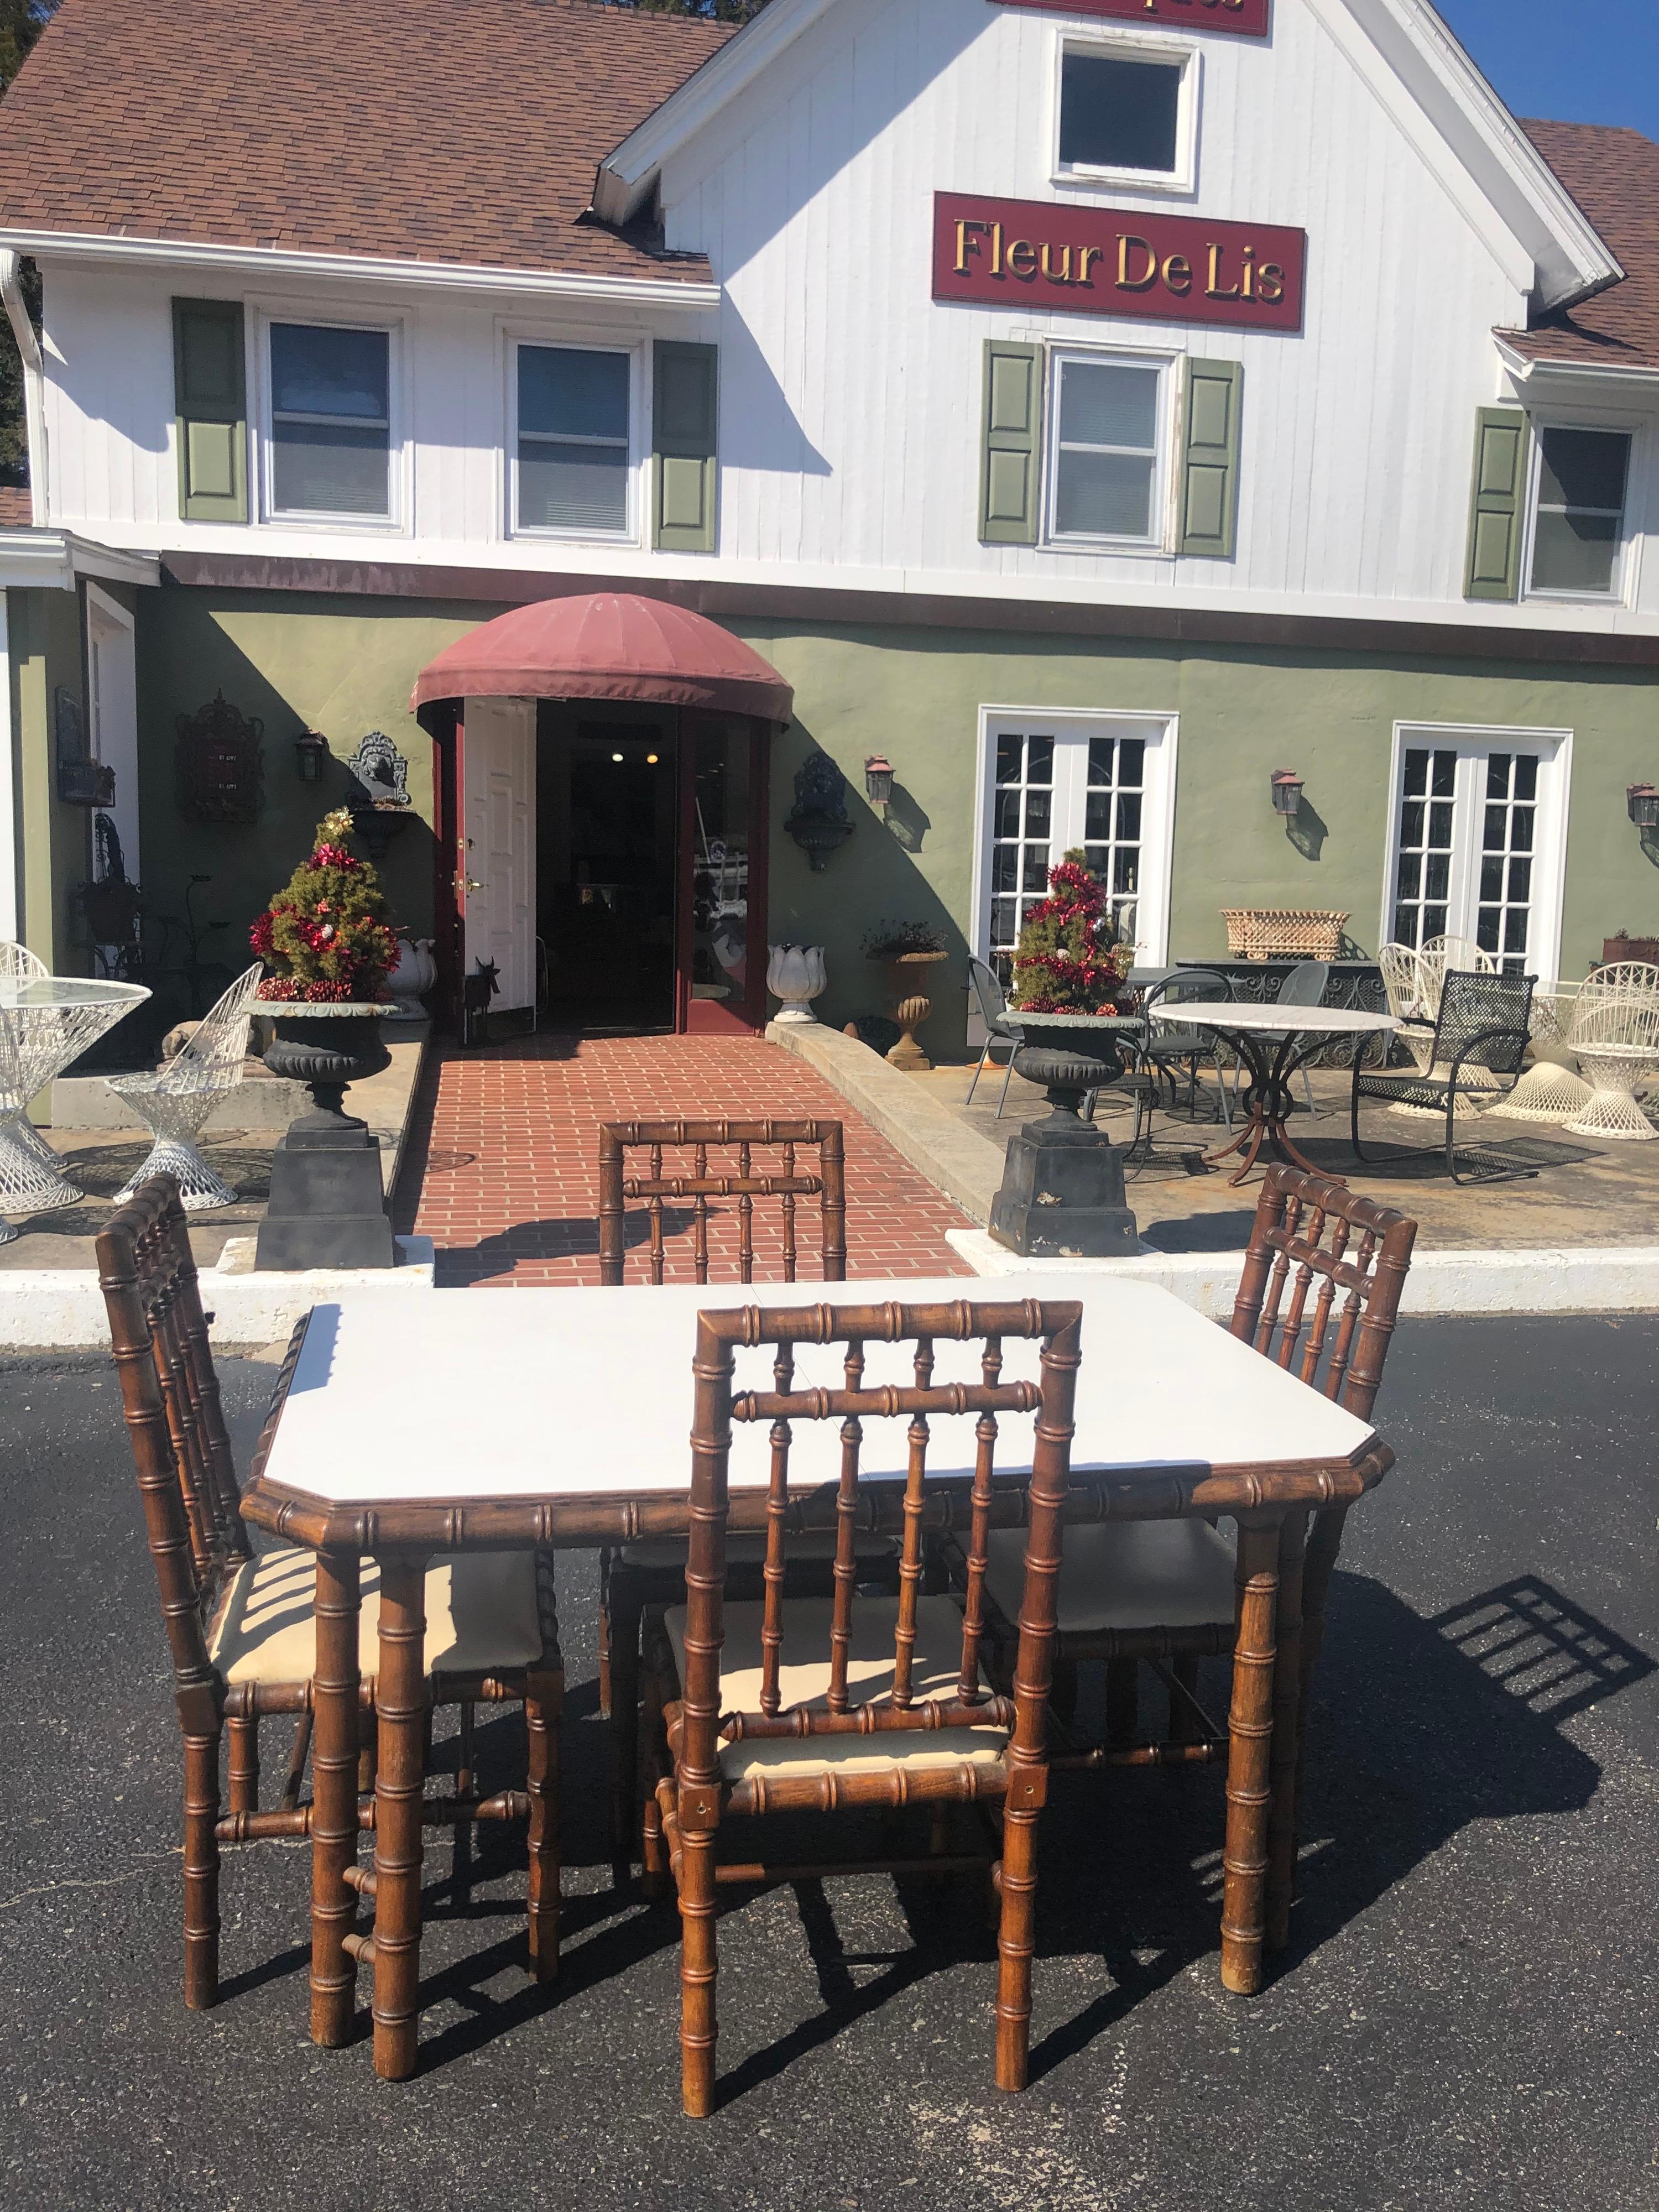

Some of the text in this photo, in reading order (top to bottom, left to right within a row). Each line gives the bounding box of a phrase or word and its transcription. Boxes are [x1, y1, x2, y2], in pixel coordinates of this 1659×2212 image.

[953, 219, 1284, 299] Fleur De Lis
